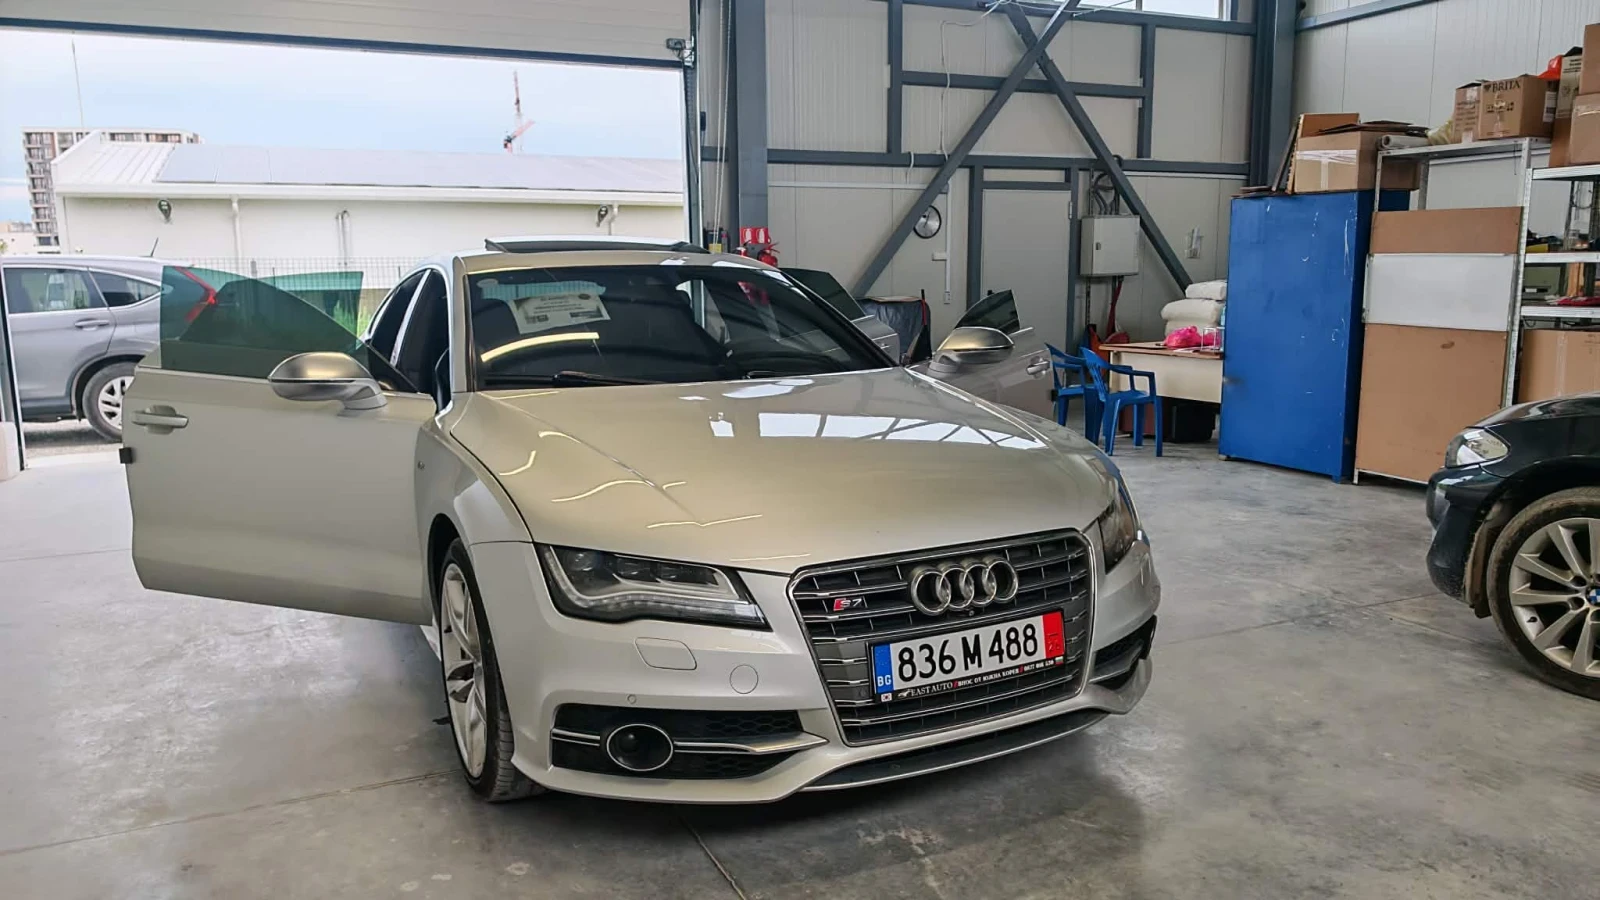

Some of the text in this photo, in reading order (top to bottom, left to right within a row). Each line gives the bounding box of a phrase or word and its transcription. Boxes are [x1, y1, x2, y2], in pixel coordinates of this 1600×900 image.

[1492, 80, 1520, 92] BRITA
[836, 598, 862, 610] S7
[898, 623, 1038, 682] 836 M 488
[877, 674, 892, 687] BG
[910, 682, 953, 697] EAST AUTO
